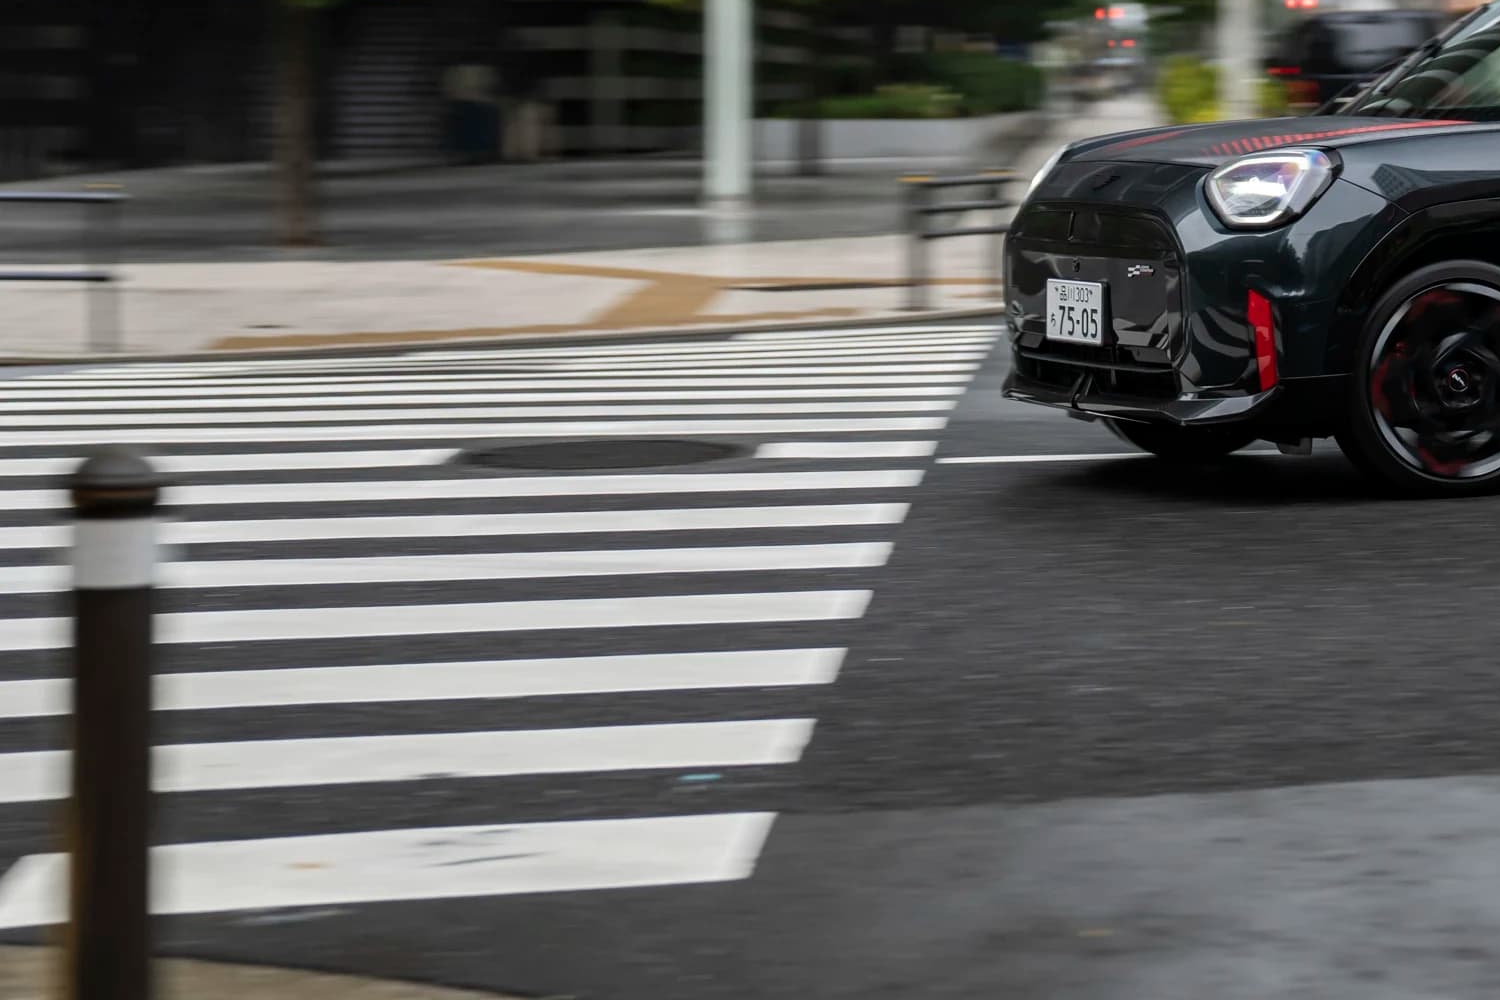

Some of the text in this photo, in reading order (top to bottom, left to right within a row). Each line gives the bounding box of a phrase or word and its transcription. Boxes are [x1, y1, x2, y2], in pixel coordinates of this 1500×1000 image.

[1060, 285, 1089, 302] 品川 303
[1059, 305, 1098, 339] 75-05
